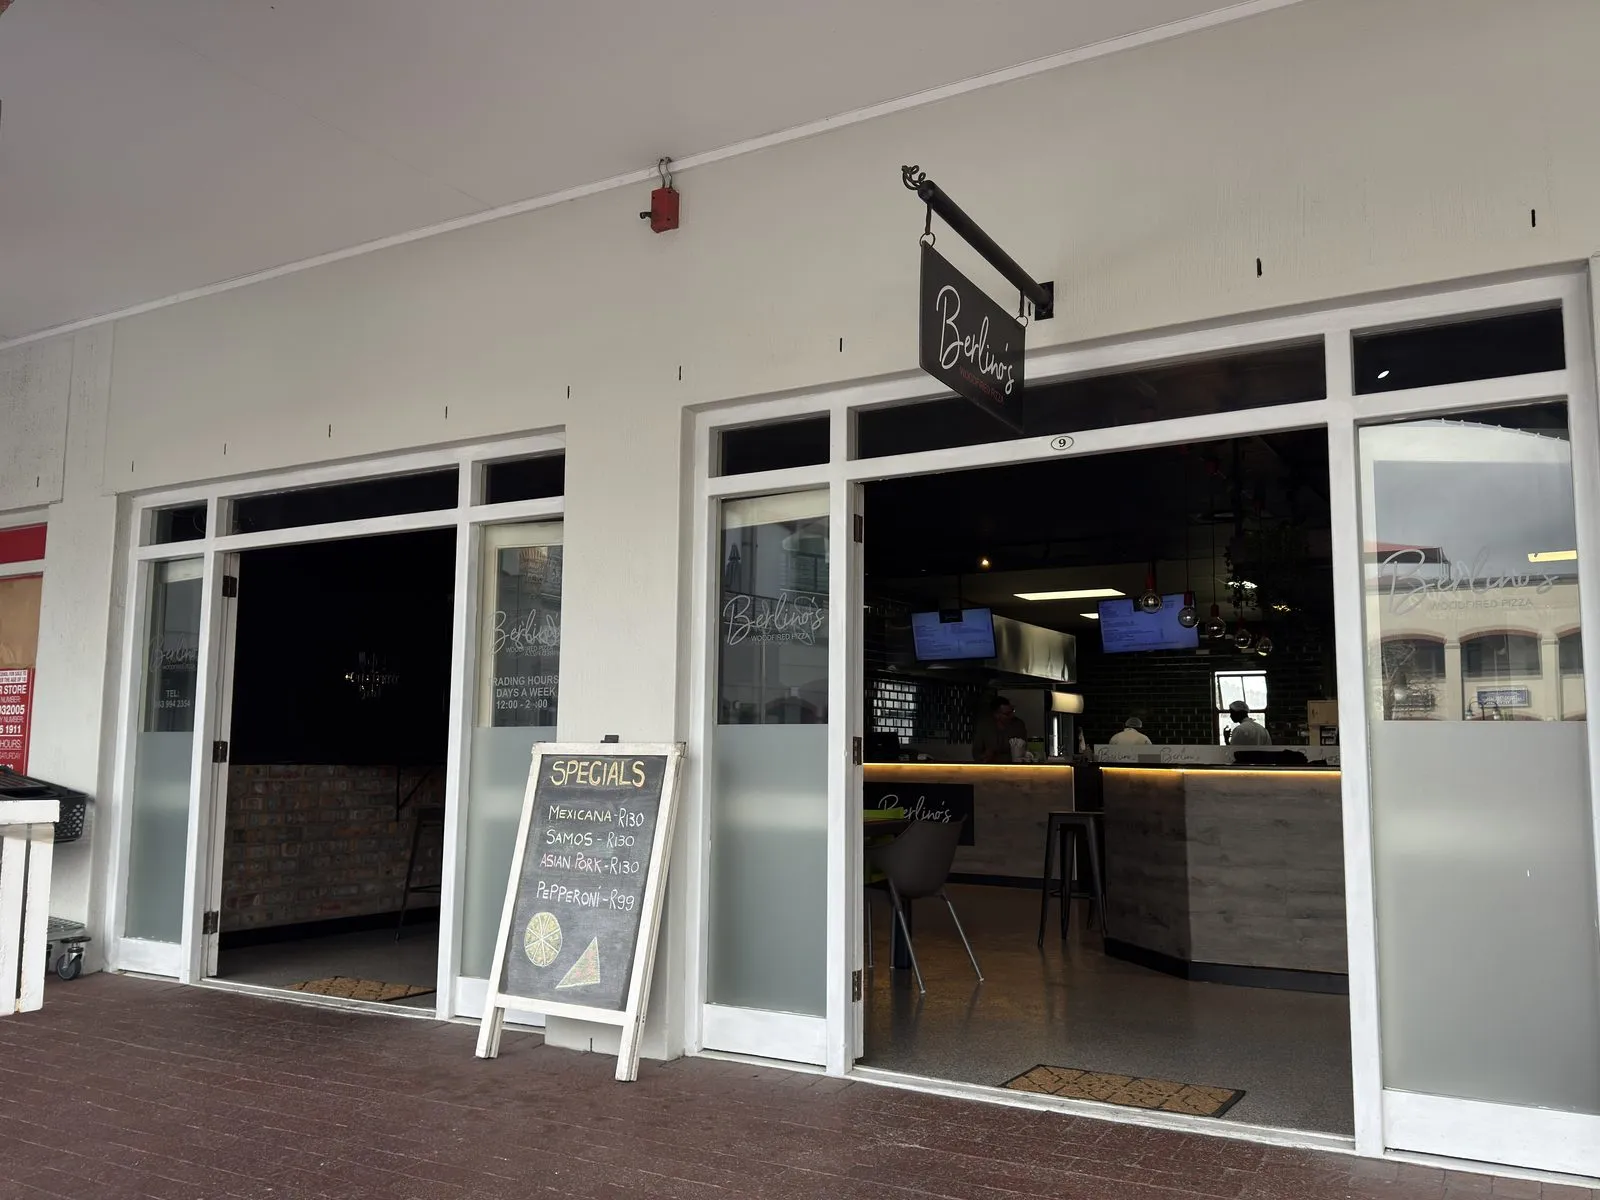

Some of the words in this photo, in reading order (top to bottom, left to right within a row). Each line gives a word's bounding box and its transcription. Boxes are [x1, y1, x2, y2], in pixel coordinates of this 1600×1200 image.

[936, 285, 1014, 394] Berlino's
[1058, 438, 1067, 448] 9
[723, 592, 825, 646] Berlino's
[750, 633, 790, 642] WOODFRED
[488, 676, 526, 686] RADING
[527, 675, 559, 685] HOURS
[4, 684, 27, 695] STORE
[496, 688, 519, 698] DAYS
[521, 688, 528, 697] A
[529, 686, 556, 697] WEEK
[496, 699, 518, 709] 12:00
[5, 724, 21, 734] 1911
[550, 759, 646, 788] SPECIALS
[546, 829, 593, 847] SAMOS
[606, 831, 635, 849] R130
[539, 852, 571, 869] ASIAN
[574, 851, 602, 873] PORK
